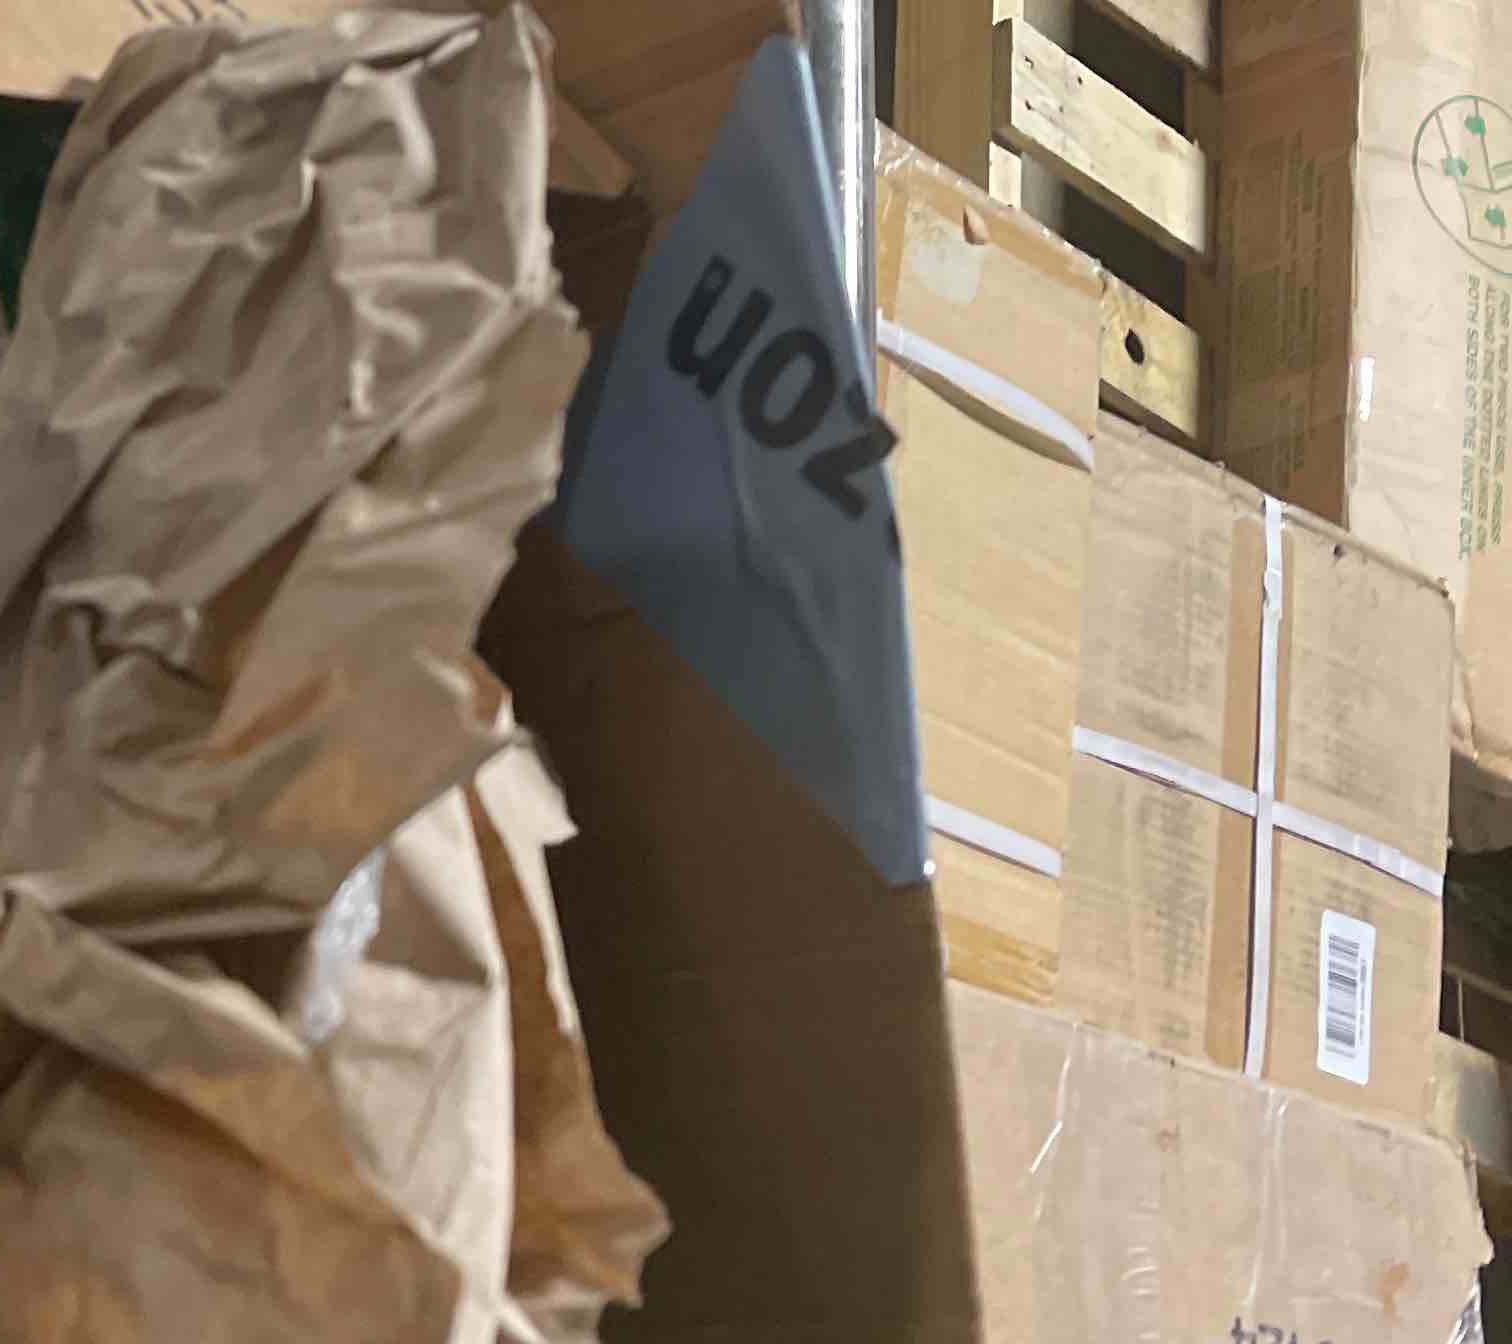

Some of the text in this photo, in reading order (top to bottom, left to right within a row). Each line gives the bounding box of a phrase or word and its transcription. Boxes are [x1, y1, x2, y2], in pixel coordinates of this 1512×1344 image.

[1467, 273, 1481, 323] BOTH
[1466, 328, 1479, 381] SIDES
[1465, 385, 1478, 412] OF
[1463, 416, 1477, 449] THE
[1461, 455, 1474, 514] INNER
